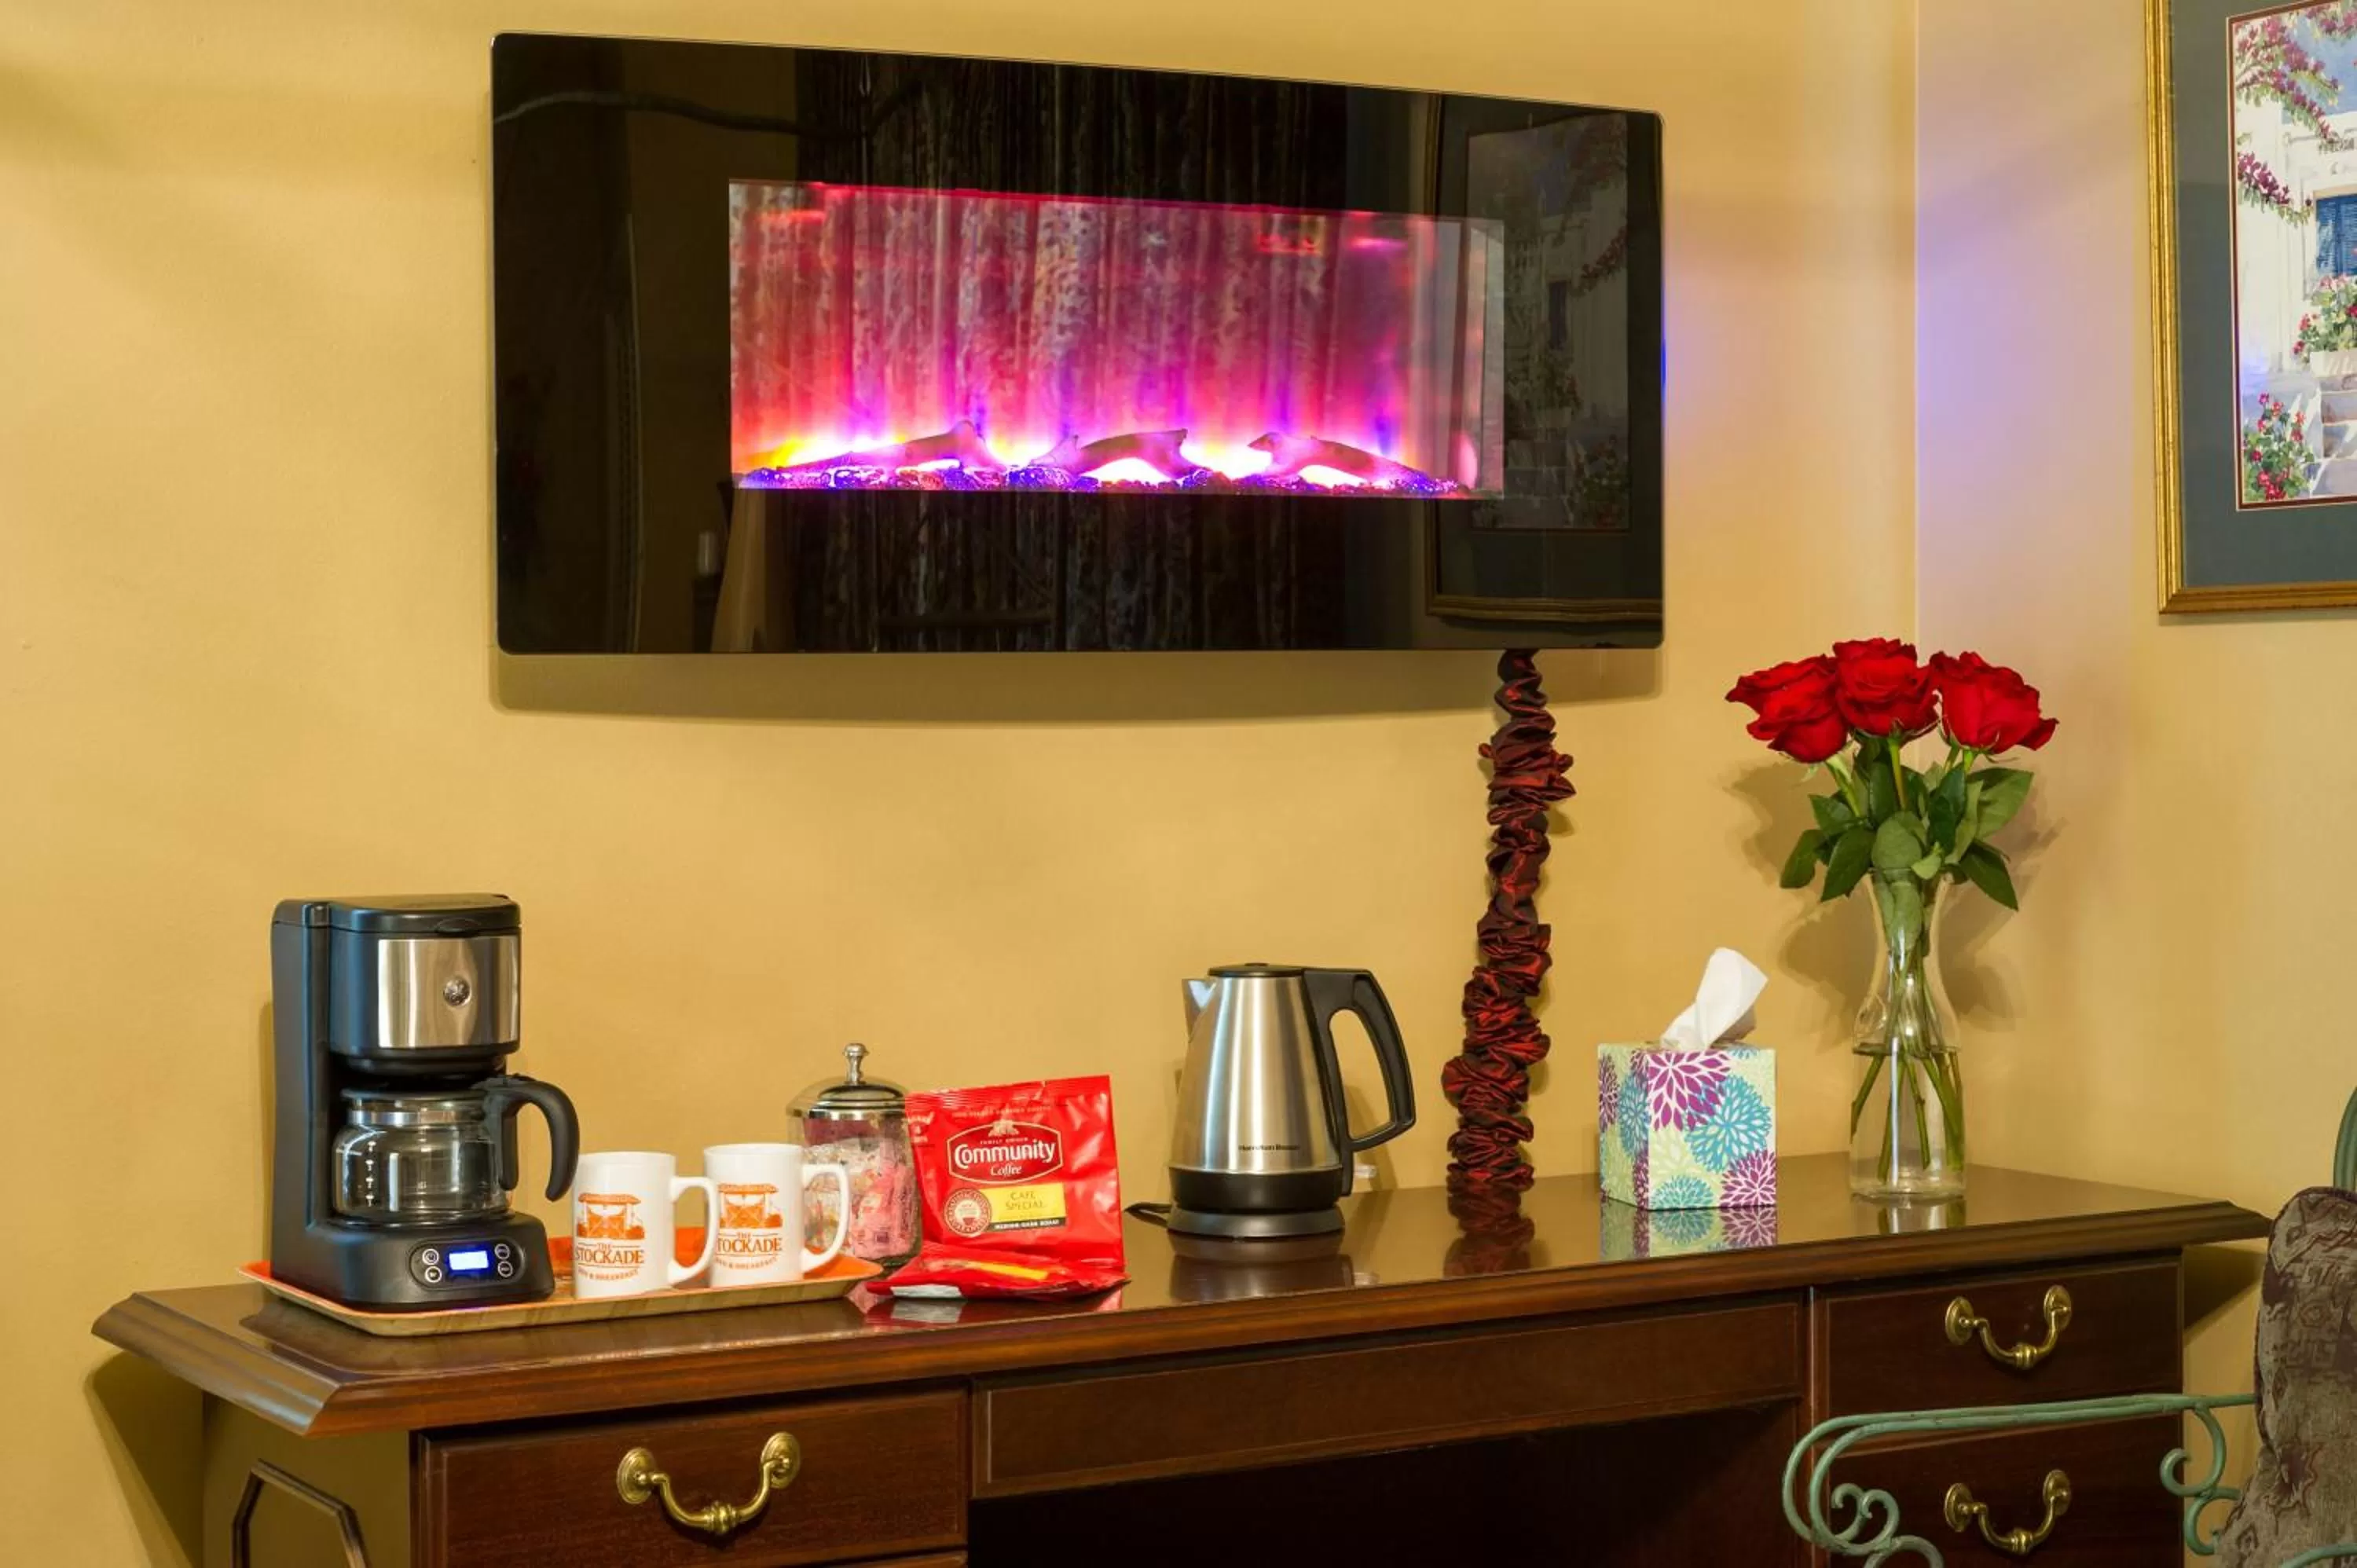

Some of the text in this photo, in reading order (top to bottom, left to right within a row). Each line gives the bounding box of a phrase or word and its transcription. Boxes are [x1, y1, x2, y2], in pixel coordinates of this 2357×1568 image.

[954, 1138, 1056, 1170] Community
[990, 1163, 1023, 1178] Coffee
[1005, 1200, 1046, 1211] SPECIAL
[575, 1246, 645, 1264] STOCKADE
